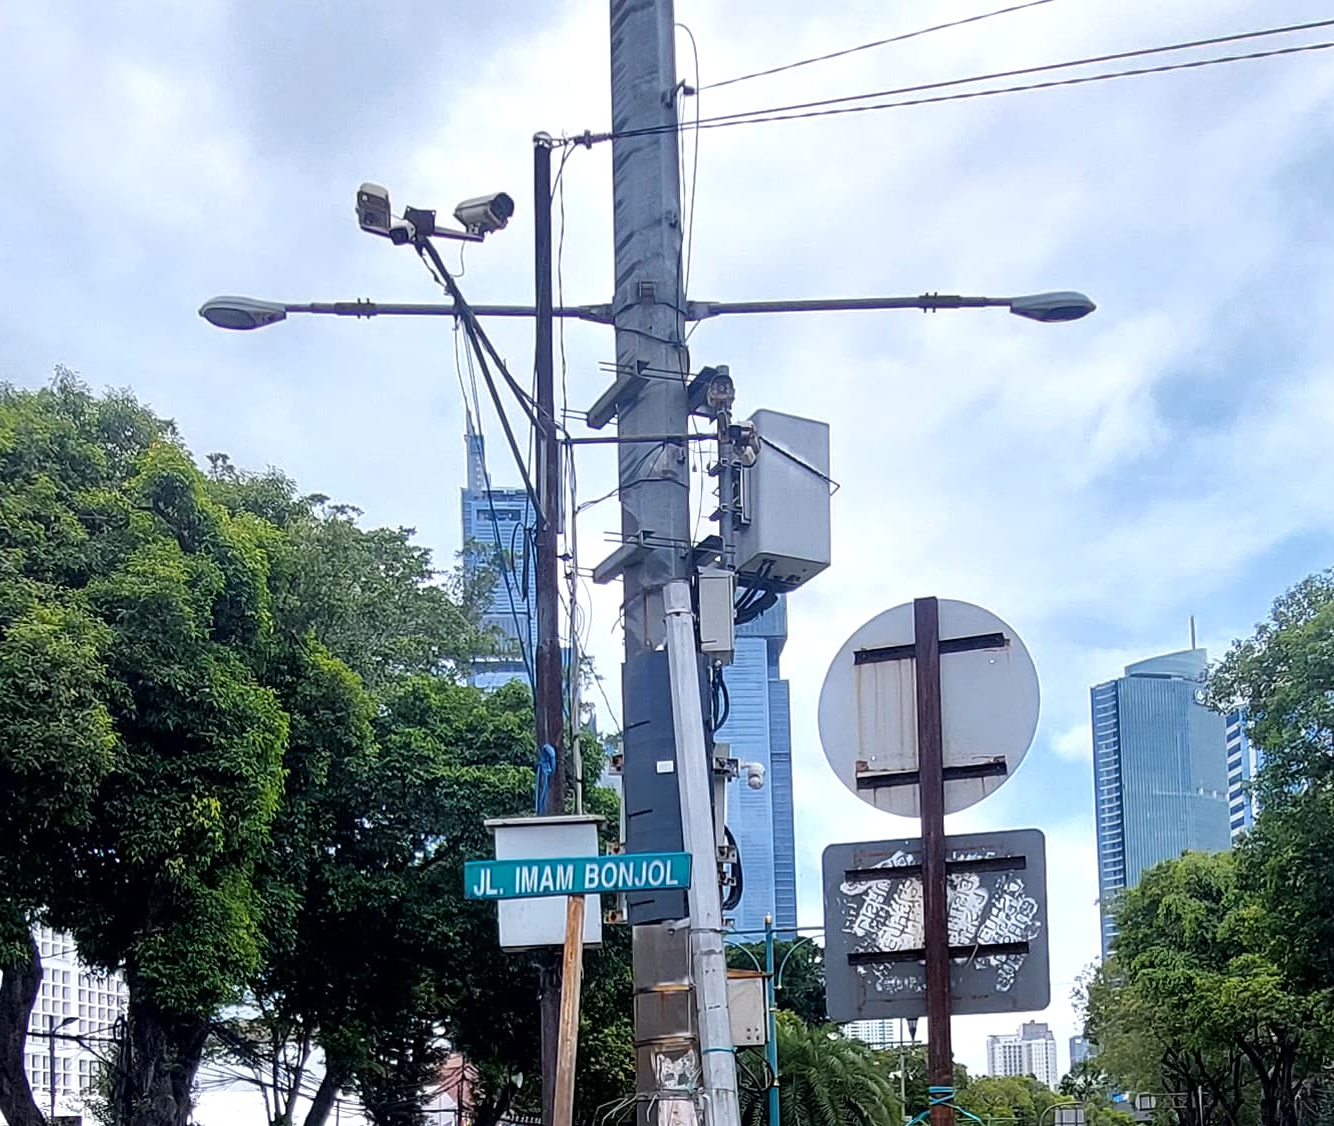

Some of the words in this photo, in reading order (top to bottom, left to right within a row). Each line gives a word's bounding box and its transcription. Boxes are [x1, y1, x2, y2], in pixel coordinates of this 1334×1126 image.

[473, 868, 504, 896] JL.
[515, 863, 574, 894] IMAM
[584, 859, 679, 889] BONJOL
